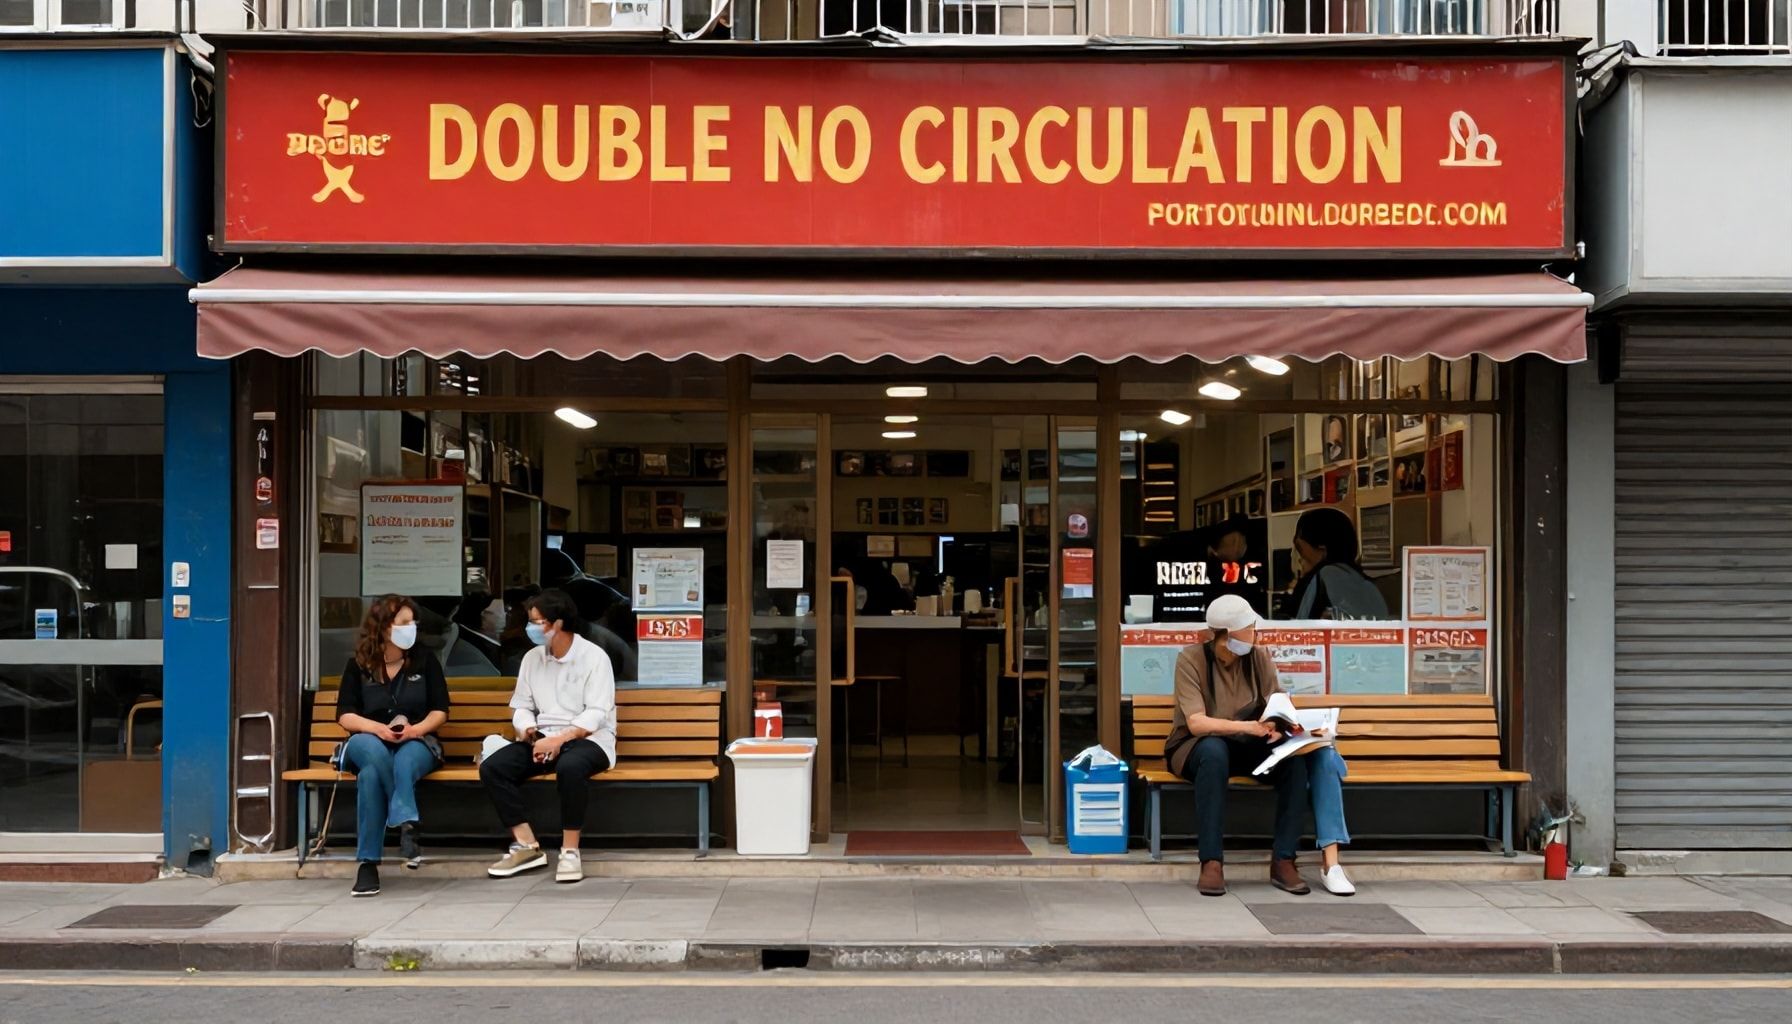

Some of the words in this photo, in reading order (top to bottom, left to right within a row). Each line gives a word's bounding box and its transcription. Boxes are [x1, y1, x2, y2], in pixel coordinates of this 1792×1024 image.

[428, 103, 731, 183] DOUBLE
[763, 104, 872, 184] NO
[899, 104, 1402, 185] CIRCULATION
